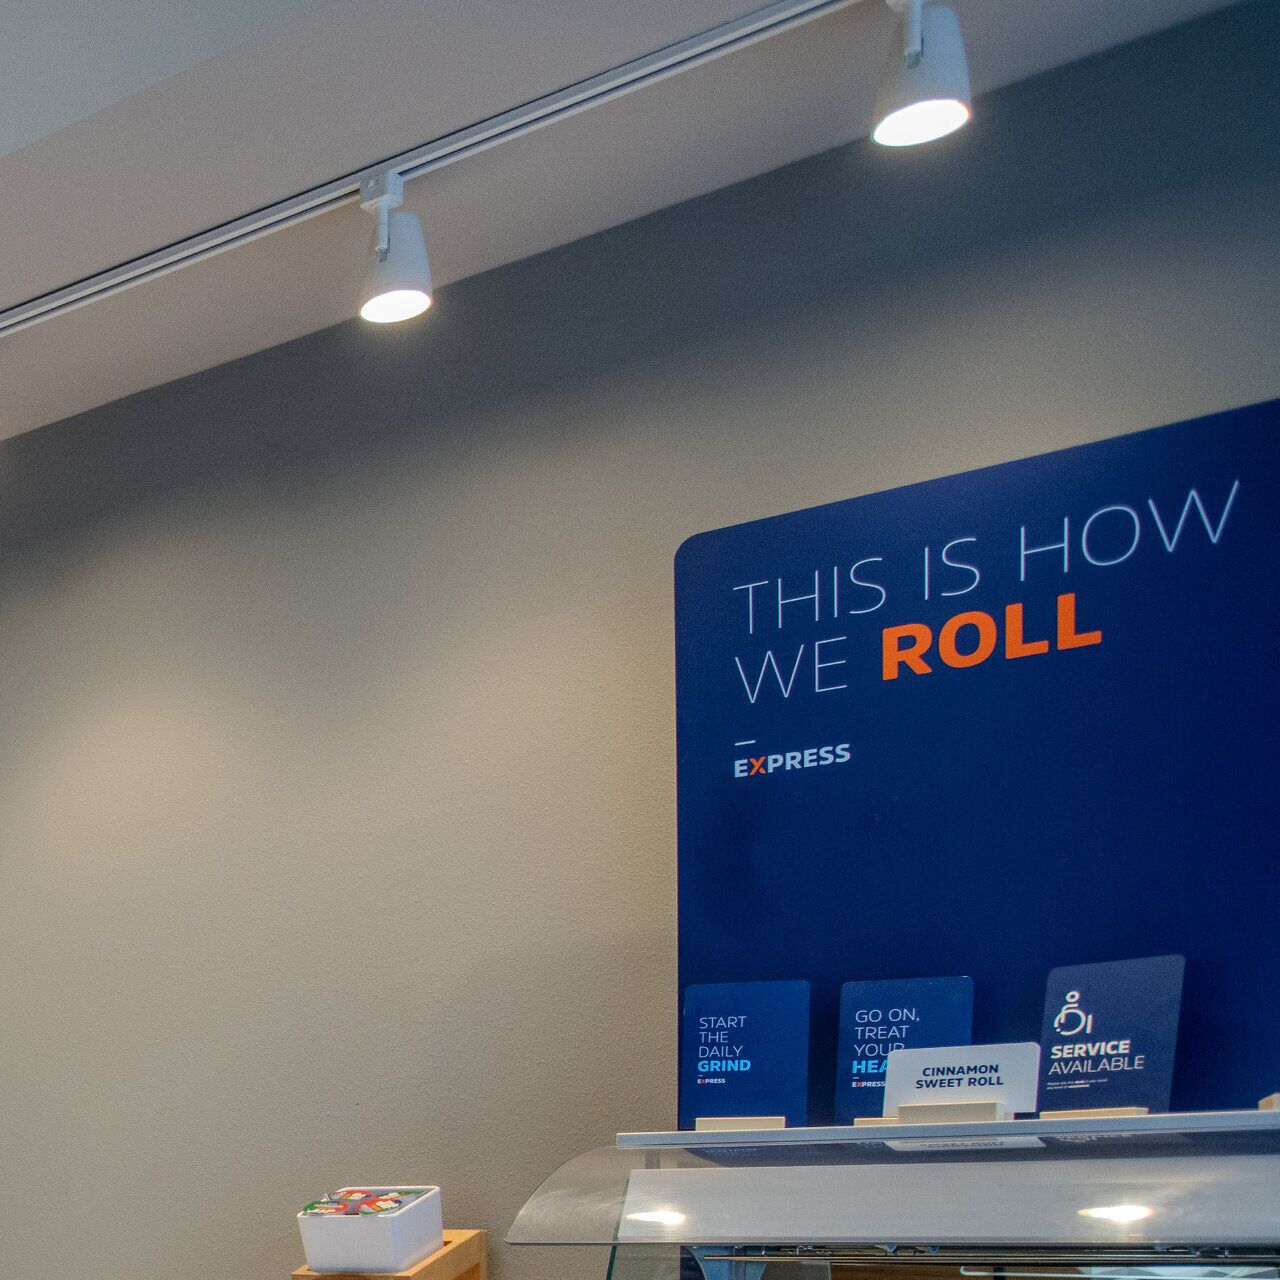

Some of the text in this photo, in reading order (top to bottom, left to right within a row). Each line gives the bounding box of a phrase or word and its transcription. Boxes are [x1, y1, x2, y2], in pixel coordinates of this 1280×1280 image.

[732, 479, 1240, 634] THIS IS HOW
[734, 592, 1103, 704] WE ROLL
[733, 742, 852, 779] EXPRESS
[698, 1015, 748, 1029] START
[854, 1007, 921, 1023] GO ON,
[698, 1031, 730, 1044] THE
[854, 1025, 910, 1040] TREAT
[697, 1045, 744, 1058] DAILY
[1050, 1039, 1132, 1060] SERVICE
[697, 1059, 751, 1073] GRIND
[922, 1064, 1000, 1077] CINNAMON
[1048, 1055, 1146, 1076] AVAILABLE
[696, 1077, 726, 1085] EXPRESS
[915, 1076, 1004, 1089] SWEET ROLL
